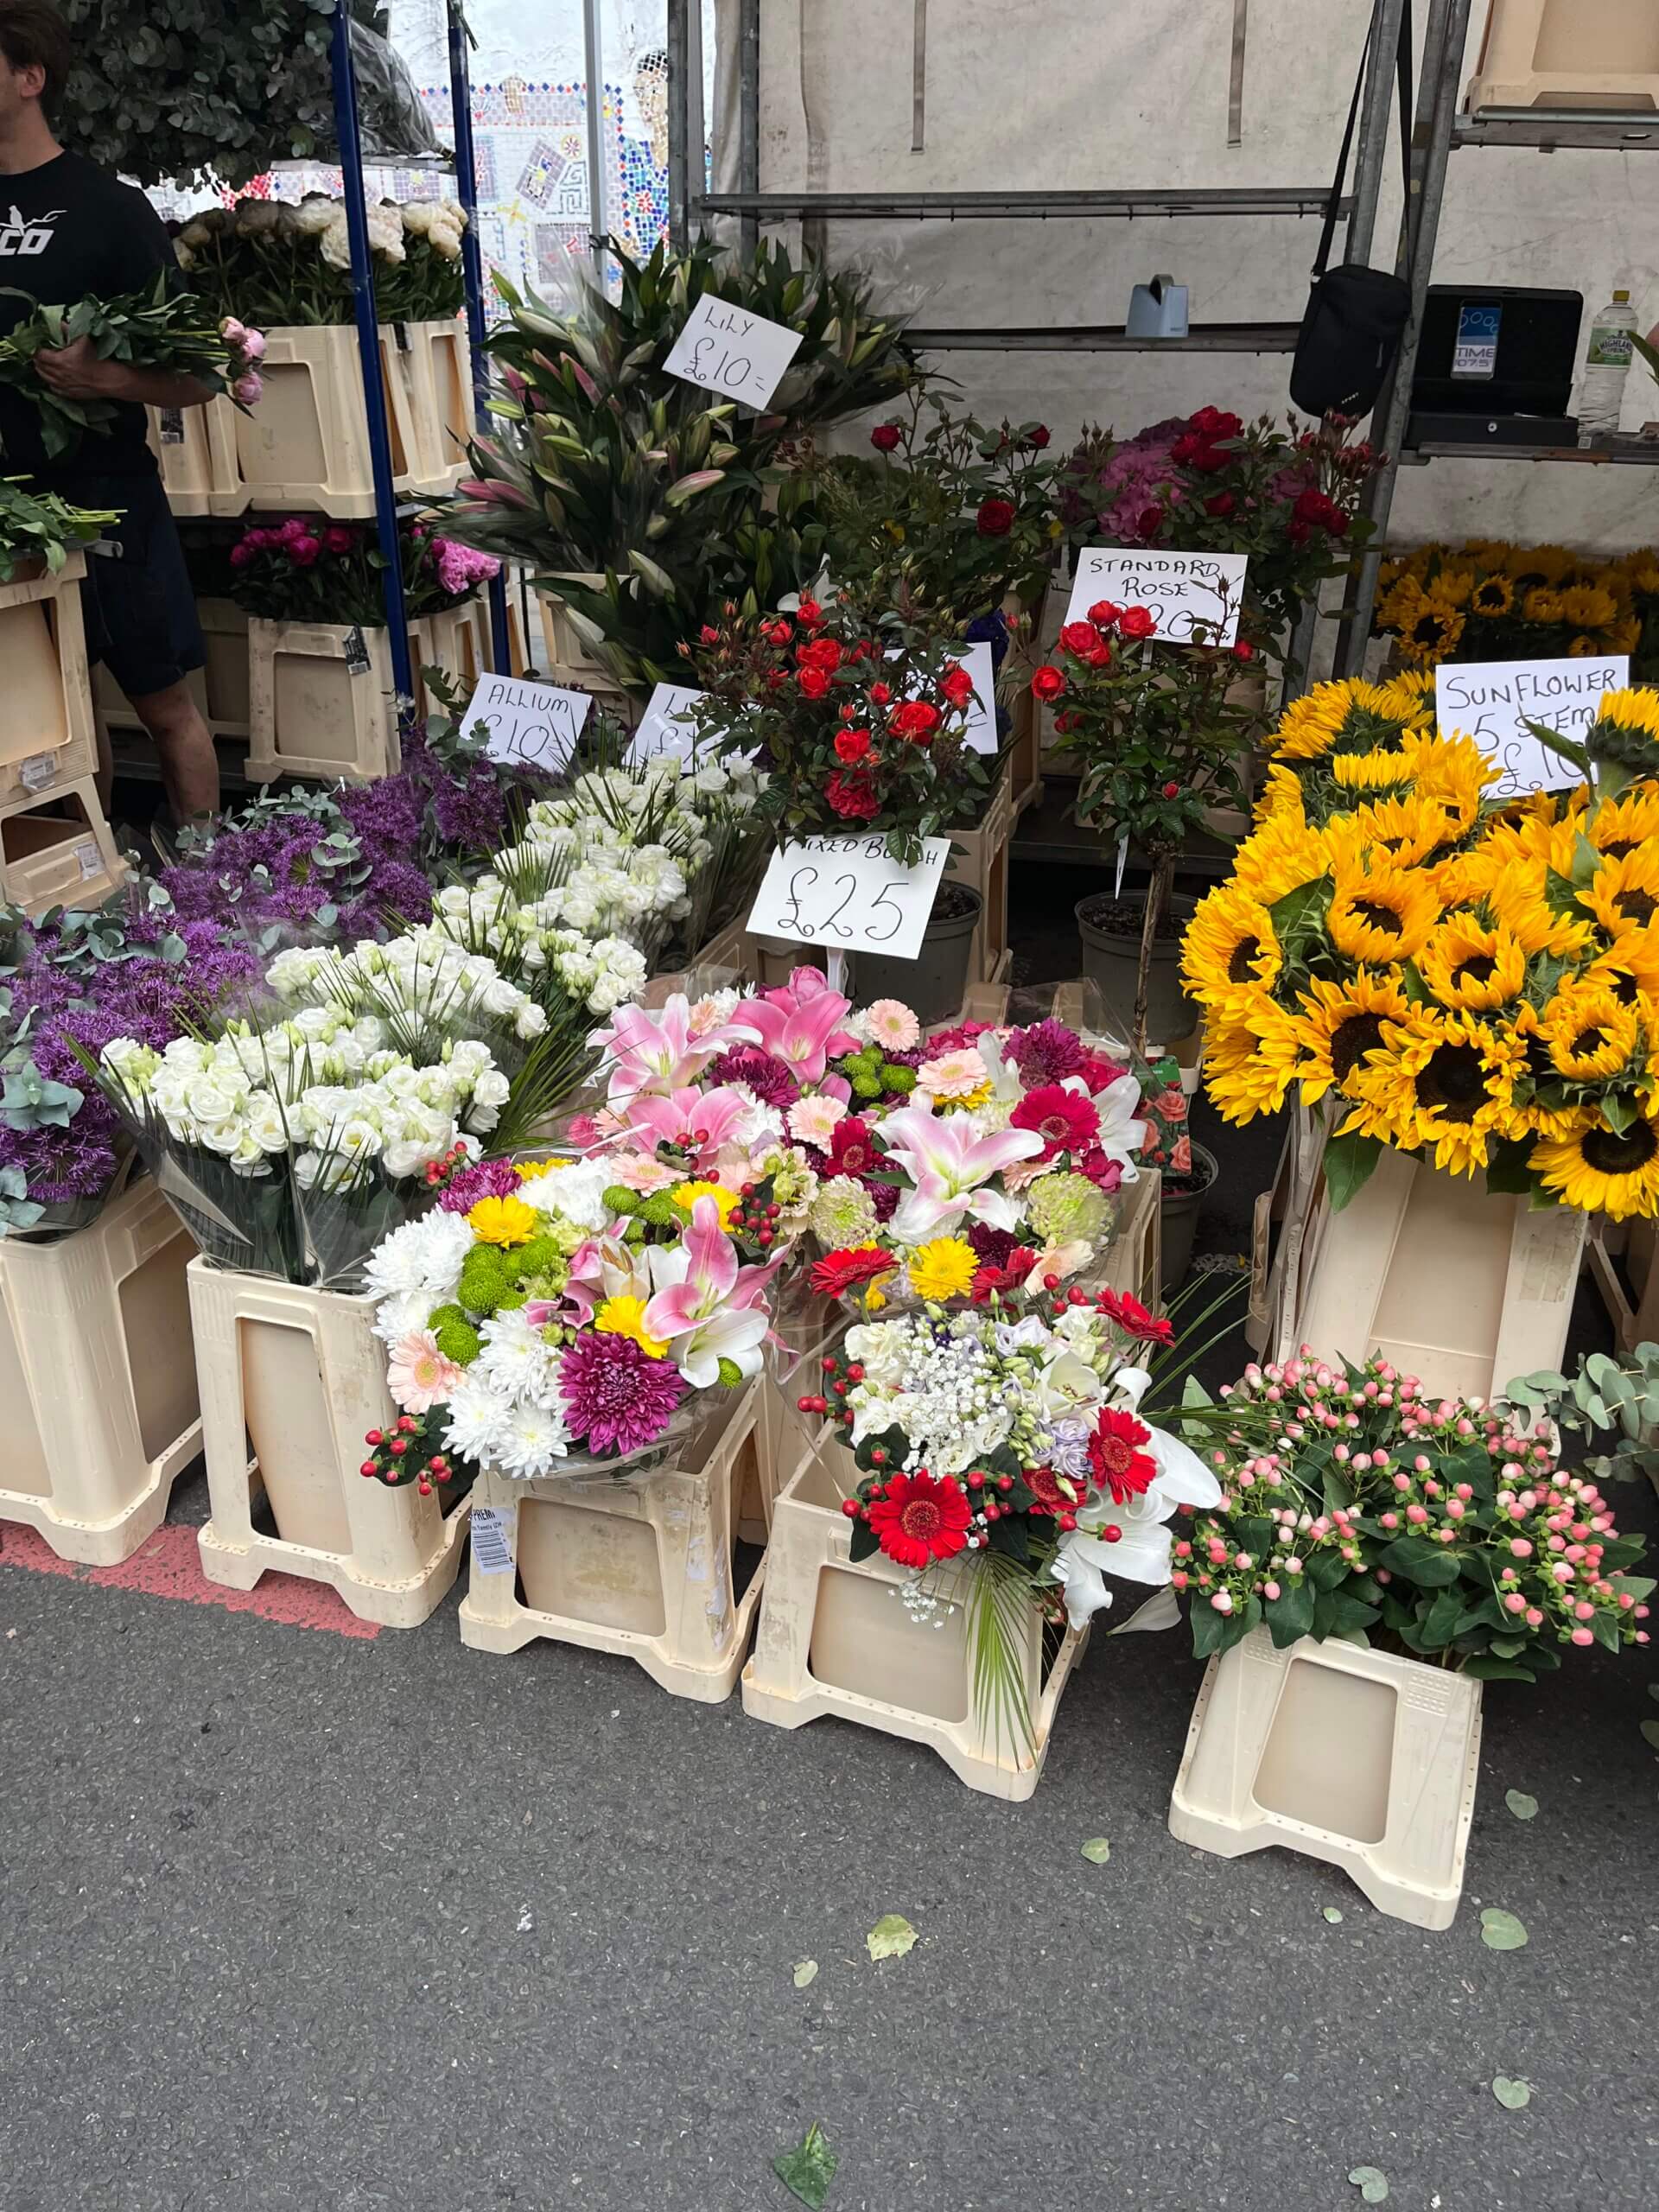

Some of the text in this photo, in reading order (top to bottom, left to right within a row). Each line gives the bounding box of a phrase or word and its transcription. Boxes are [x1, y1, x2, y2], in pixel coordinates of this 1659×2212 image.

[0, 228, 54, 255] CO
[704, 306, 753, 336] LILY
[1458, 347, 1494, 358] TIME
[1090, 558, 1220, 577] STANDARD
[1122, 576, 1189, 598] ROSE
[488, 684, 569, 714] ALLIUM
[1446, 669, 1616, 709] SUNFLOWER
[1473, 713, 1500, 752] 5
[778, 867, 910, 941] £25
